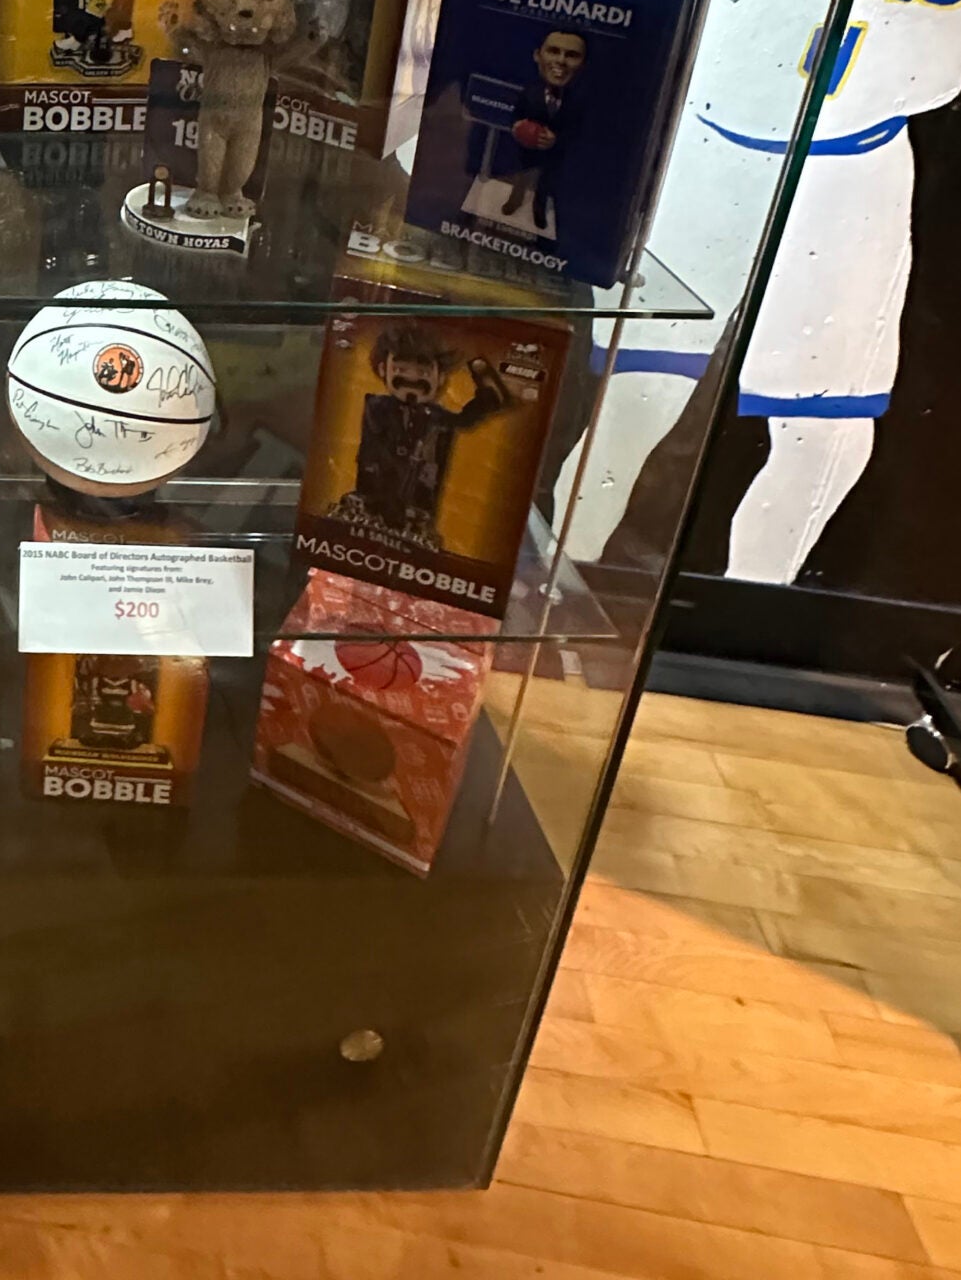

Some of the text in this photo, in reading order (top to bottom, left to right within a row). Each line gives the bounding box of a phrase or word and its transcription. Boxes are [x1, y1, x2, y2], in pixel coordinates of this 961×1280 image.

[25, 90, 92, 104] MASCOT
[23, 105, 147, 131] BOBBLE
[272, 106, 358, 151] OBBLE
[182, 236, 230, 249] HOYAS
[440, 219, 568, 273] BRACKETOLOGY
[52, 529, 126, 544] MASCOT
[22, 550, 252, 564] 2015 NABC Board of Directors Autographed Basketball
[114, 599, 160, 620] $200
[44, 764, 116, 780] MASCOT
[43, 776, 172, 805] BOBBLE
